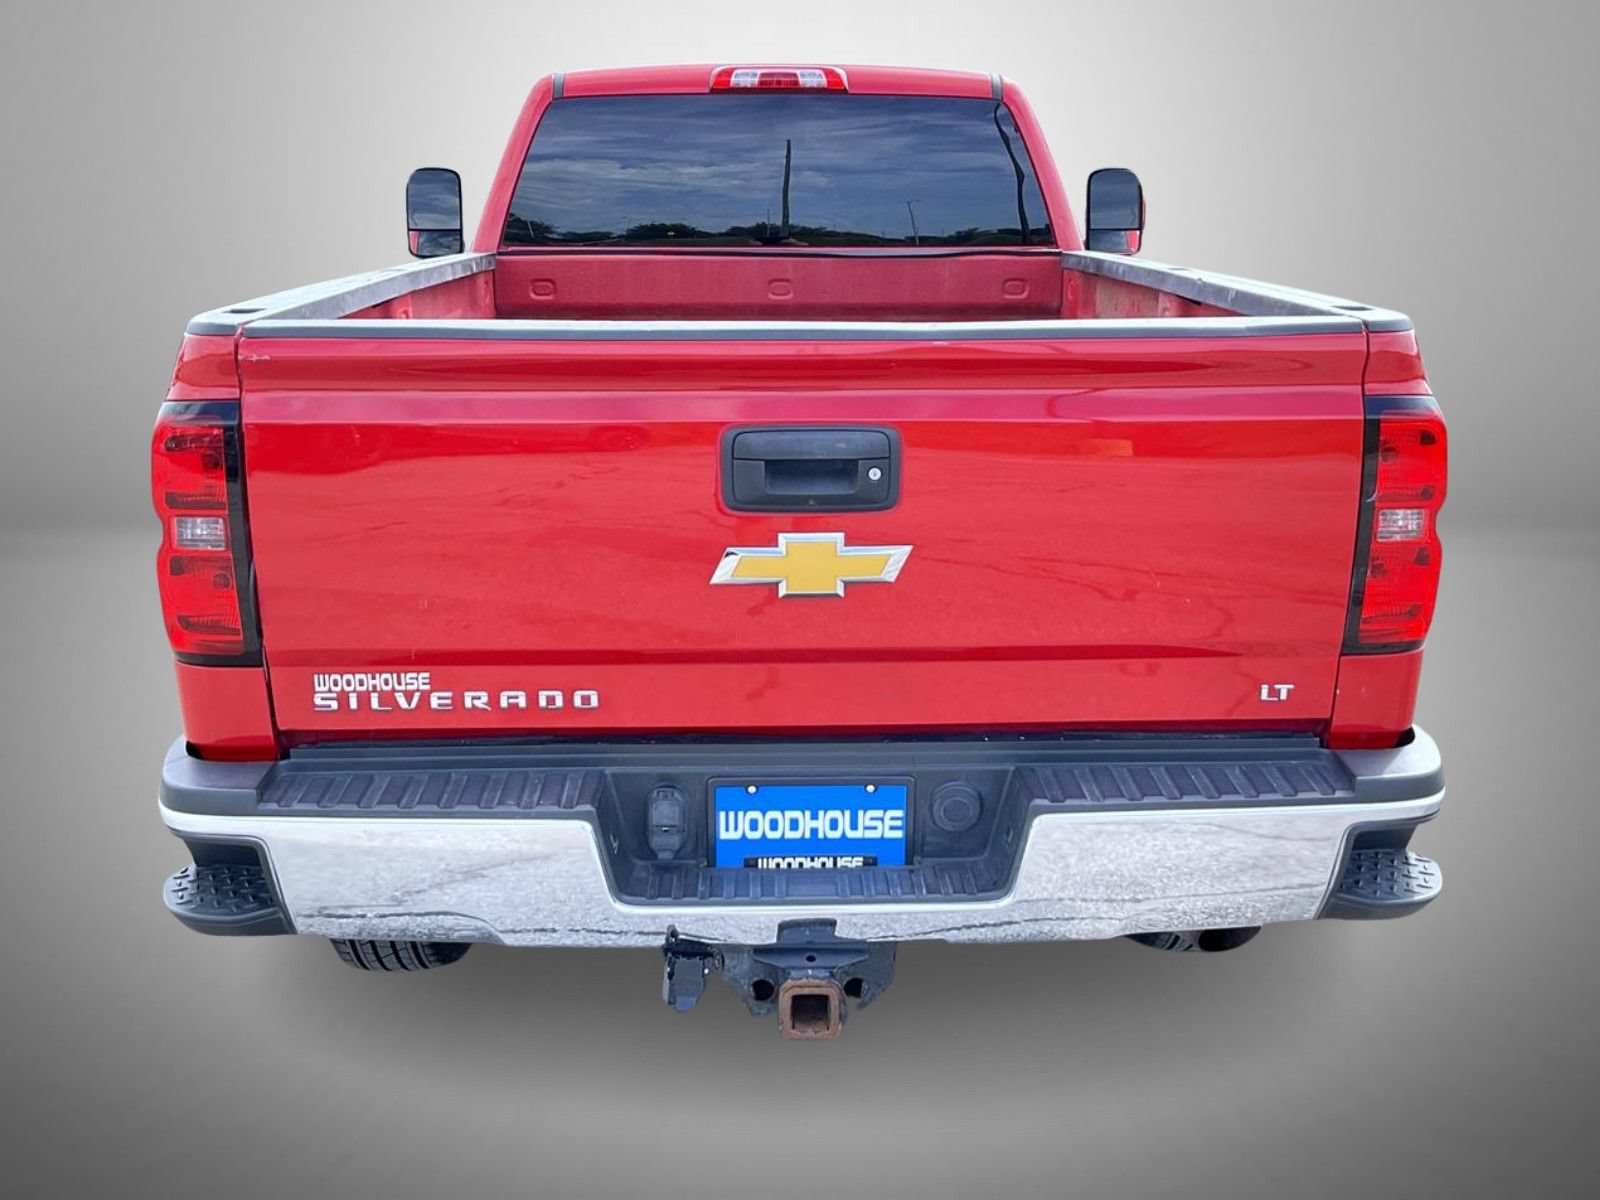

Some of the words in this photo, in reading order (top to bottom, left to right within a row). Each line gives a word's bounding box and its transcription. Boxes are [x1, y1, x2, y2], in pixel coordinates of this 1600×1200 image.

[313, 673, 431, 691] WOODHOUSE
[313, 690, 600, 712] SILVERADO
[1260, 683, 1295, 702] LT
[718, 809, 905, 840] WOODHOUSE
